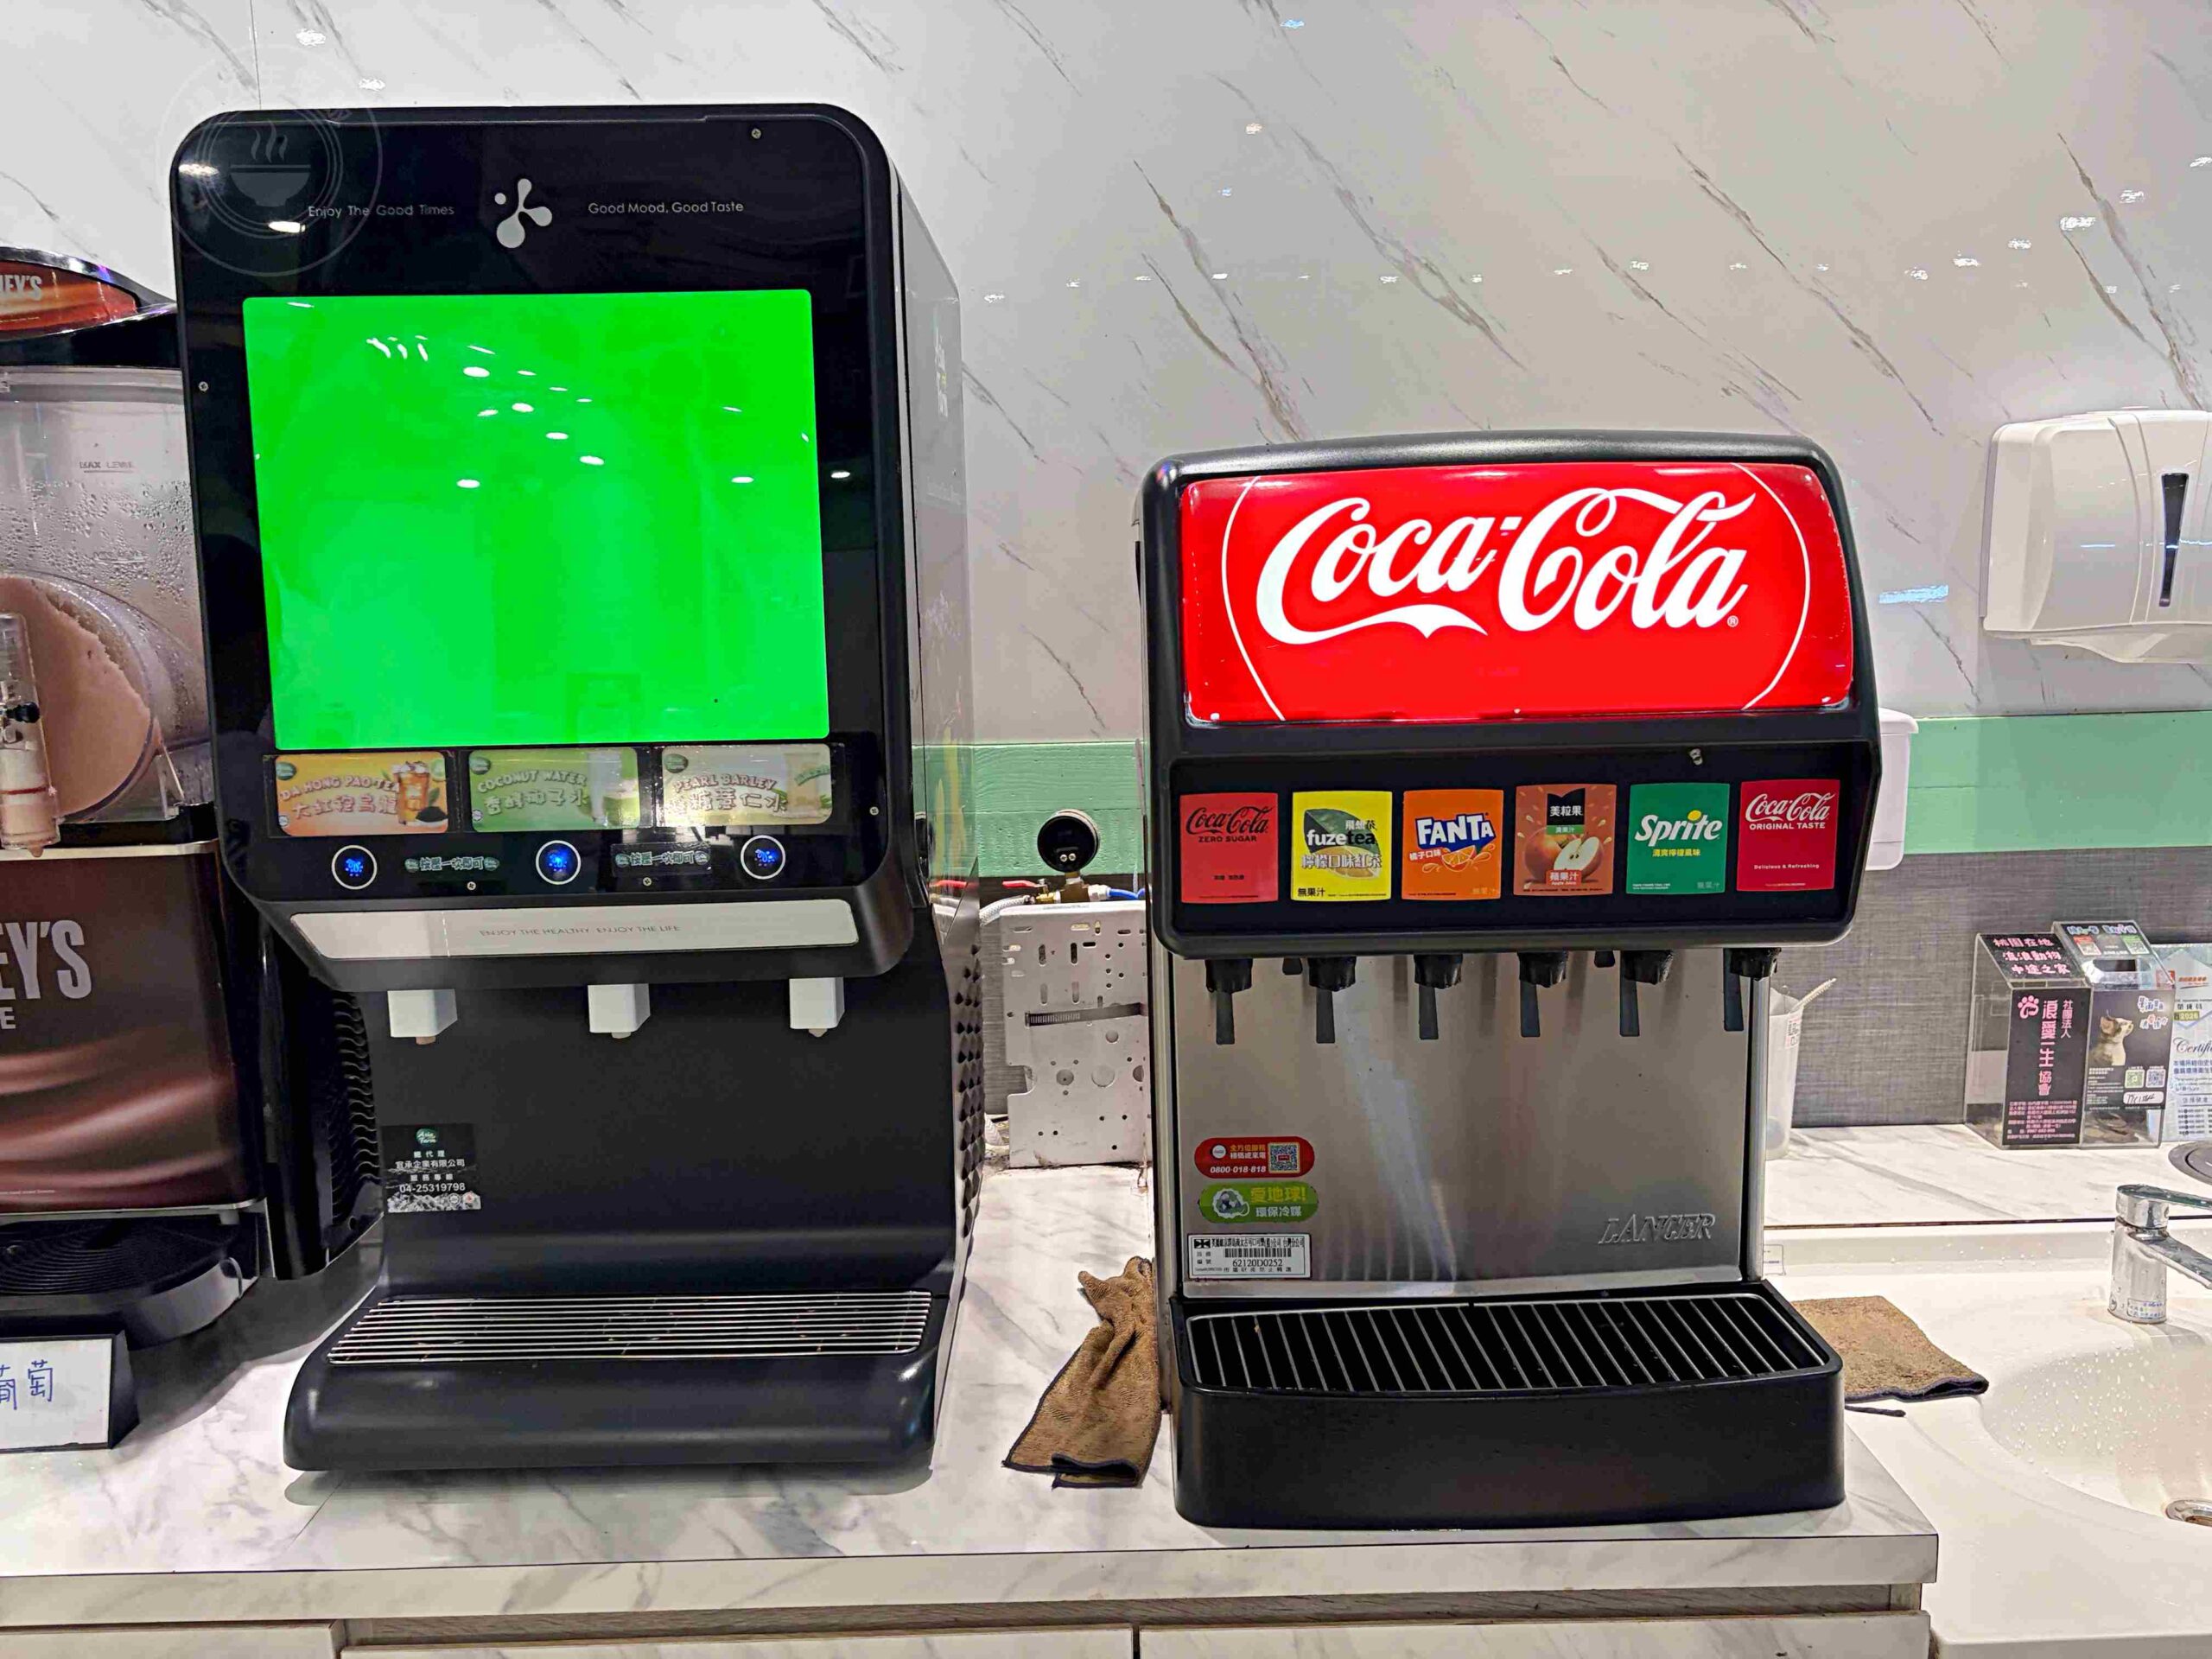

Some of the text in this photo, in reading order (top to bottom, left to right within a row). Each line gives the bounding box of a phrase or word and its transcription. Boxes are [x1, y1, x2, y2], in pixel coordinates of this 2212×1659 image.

[308, 204, 455, 218] Enjoy The Good Times
[588, 202, 625, 214] Good
[671, 201, 709, 213] Good
[710, 200, 745, 213] Taste
[1255, 487, 1757, 645] Coca-Cola
[280, 777, 400, 801] DA HONG PAO TEA
[478, 770, 588, 793] COCONUT WATER
[674, 773, 777, 793] PEARL BARLEY
[1549, 805, 1583, 817] 美粒果
[1745, 792, 1836, 823] Coca-Cola
[1185, 806, 1274, 836] Coca-Cola
[1417, 815, 1494, 845] FANTA
[1634, 810, 1723, 847] Sprite
[1297, 887, 1325, 898] 無果汁
[2003, 950, 2062, 961] 流浪動物
[2012, 963, 2070, 975] 中途之家
[2061, 1000, 2074, 1038] 社團法人
[399, 1182, 466, 1193] 04-25319798
[1255, 1206, 1302, 1217] 環保冷媒
[1598, 1213, 1716, 1244] LANCER
[1232, 1258, 1283, 1268] 62120D0252
